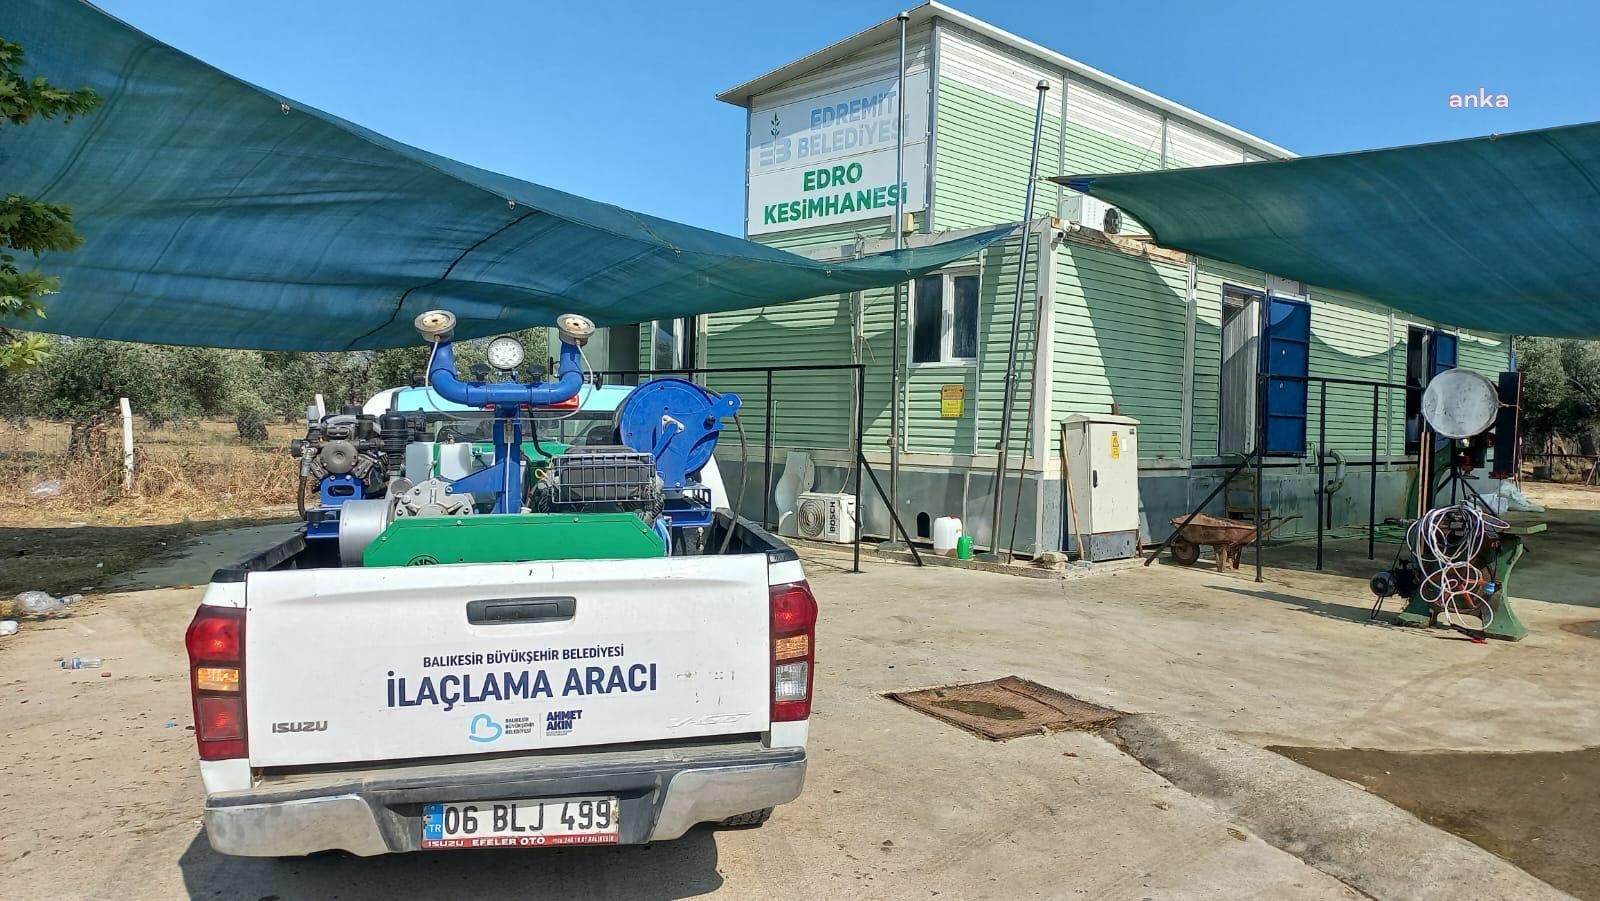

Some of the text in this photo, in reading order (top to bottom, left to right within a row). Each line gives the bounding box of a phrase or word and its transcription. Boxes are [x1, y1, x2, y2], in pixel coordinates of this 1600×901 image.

[811, 91, 896, 131] EDREMİT
[797, 114, 910, 160] BELEDİYESİ
[803, 161, 863, 192] EDRO
[764, 182, 908, 225] KESİMHANESİ
[423, 643, 625, 668] BALIKESİR BÜYÜKŞEHİR BELEDİYESİ
[387, 663, 657, 711] İLAÇLAMA ARACI
[272, 720, 328, 734] ISUZU
[546, 710, 583, 721] AHMET
[546, 720, 573, 731] AKIN
[429, 799, 611, 835] TR 06 BLJ 499
[472, 834, 518, 847] EFELER
[520, 836, 545, 846] OTO
